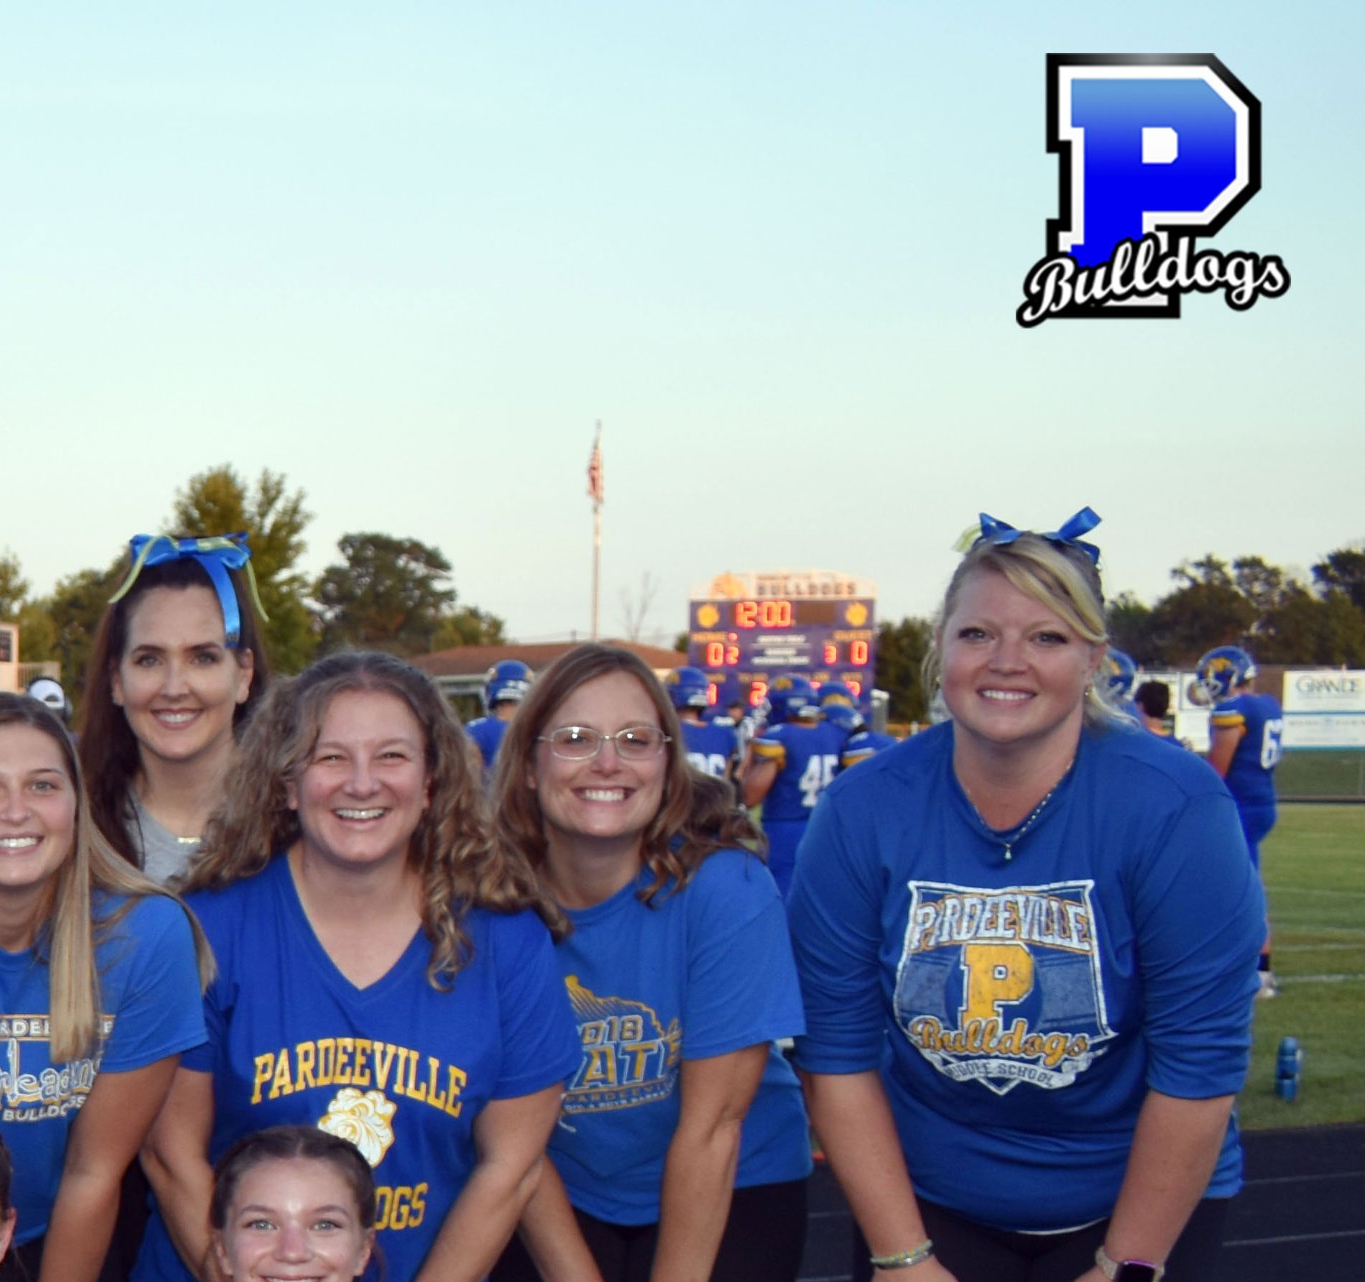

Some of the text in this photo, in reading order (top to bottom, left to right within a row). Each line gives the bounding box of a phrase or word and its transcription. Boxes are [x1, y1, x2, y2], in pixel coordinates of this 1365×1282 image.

[959, 940, 1035, 1032] P
[576, 1015, 644, 1045] 018
[909, 1015, 1090, 1067] Bulldogs
[250, 1037, 467, 1118] PARDEEVILLE
[997, 1062, 1055, 1087] SCHOOL
